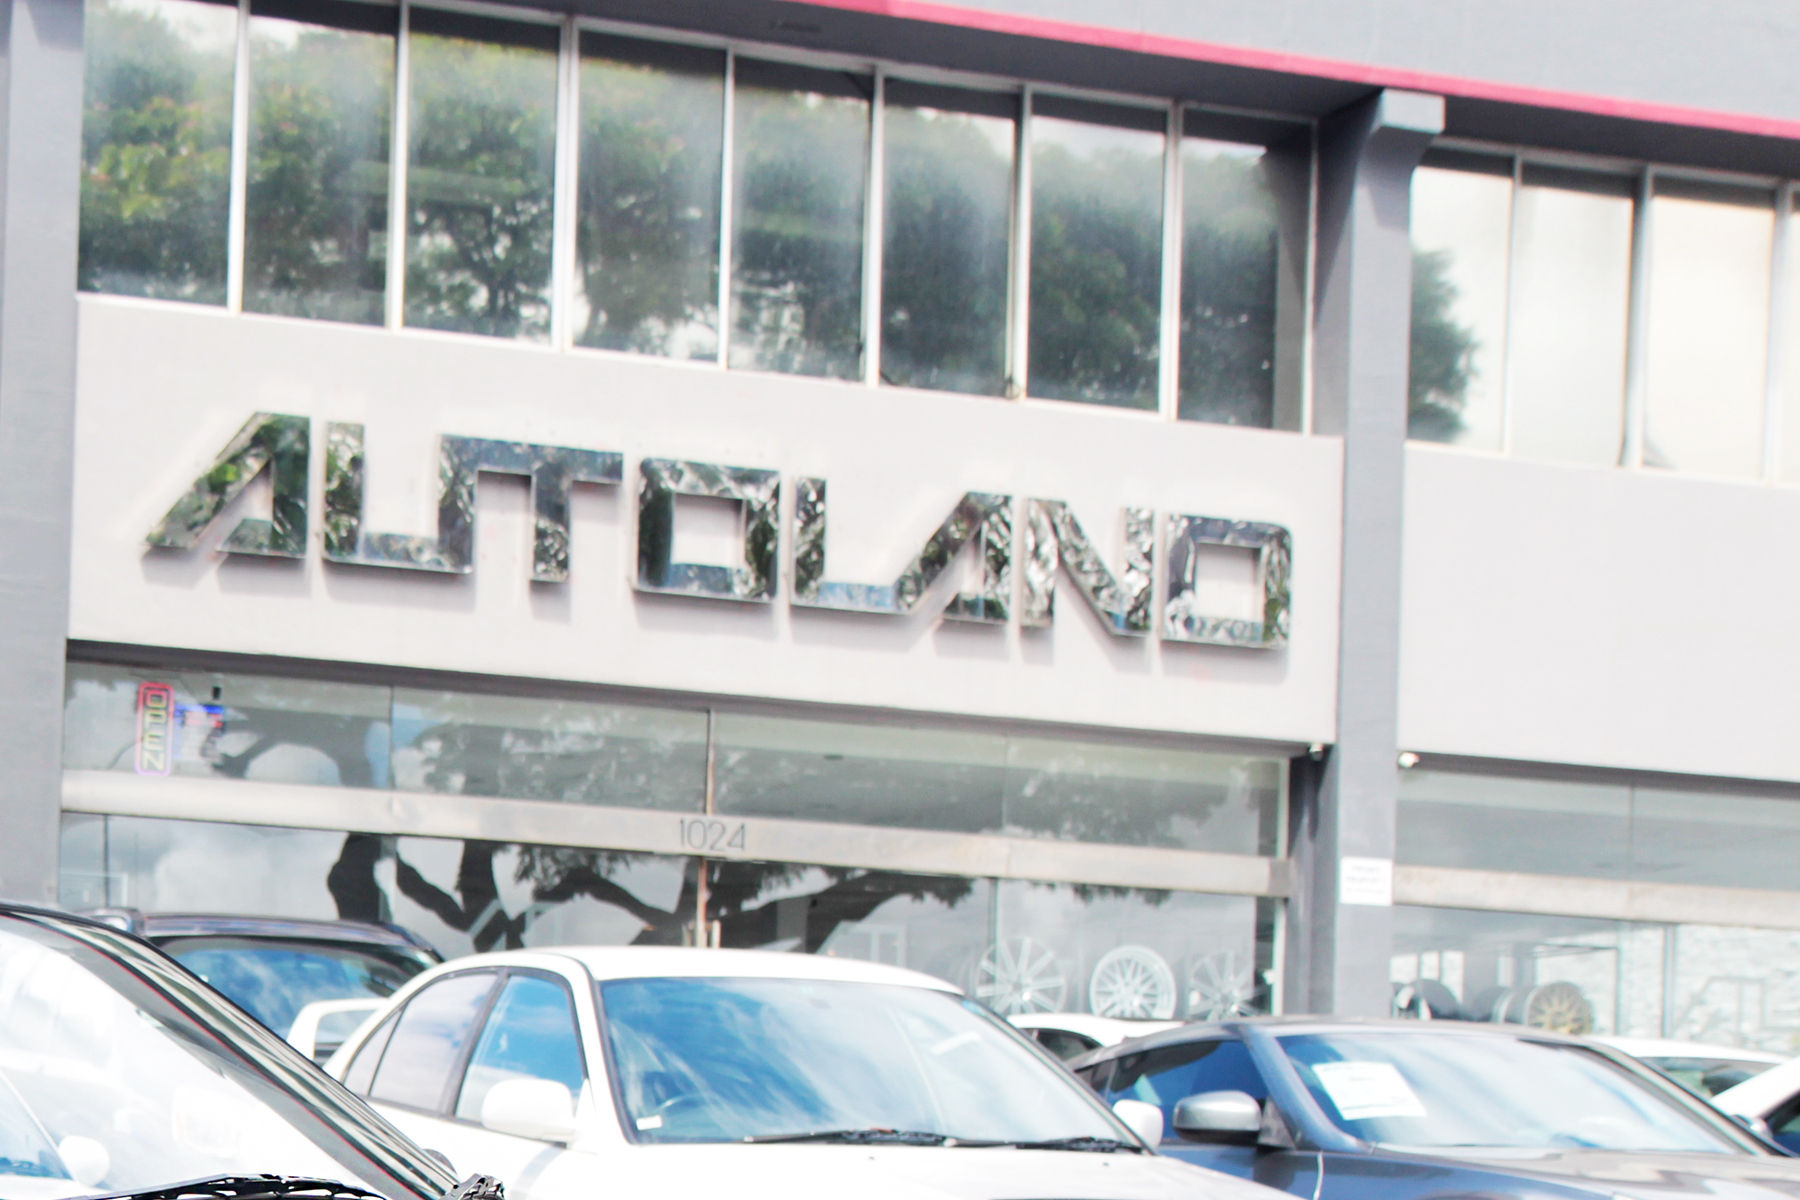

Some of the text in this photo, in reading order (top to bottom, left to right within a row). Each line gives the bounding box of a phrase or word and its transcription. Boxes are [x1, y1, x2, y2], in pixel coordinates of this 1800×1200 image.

[145, 411, 1292, 651] AUTOLAND
[143, 689, 168, 771] OPEN
[679, 817, 746, 851] 1024
